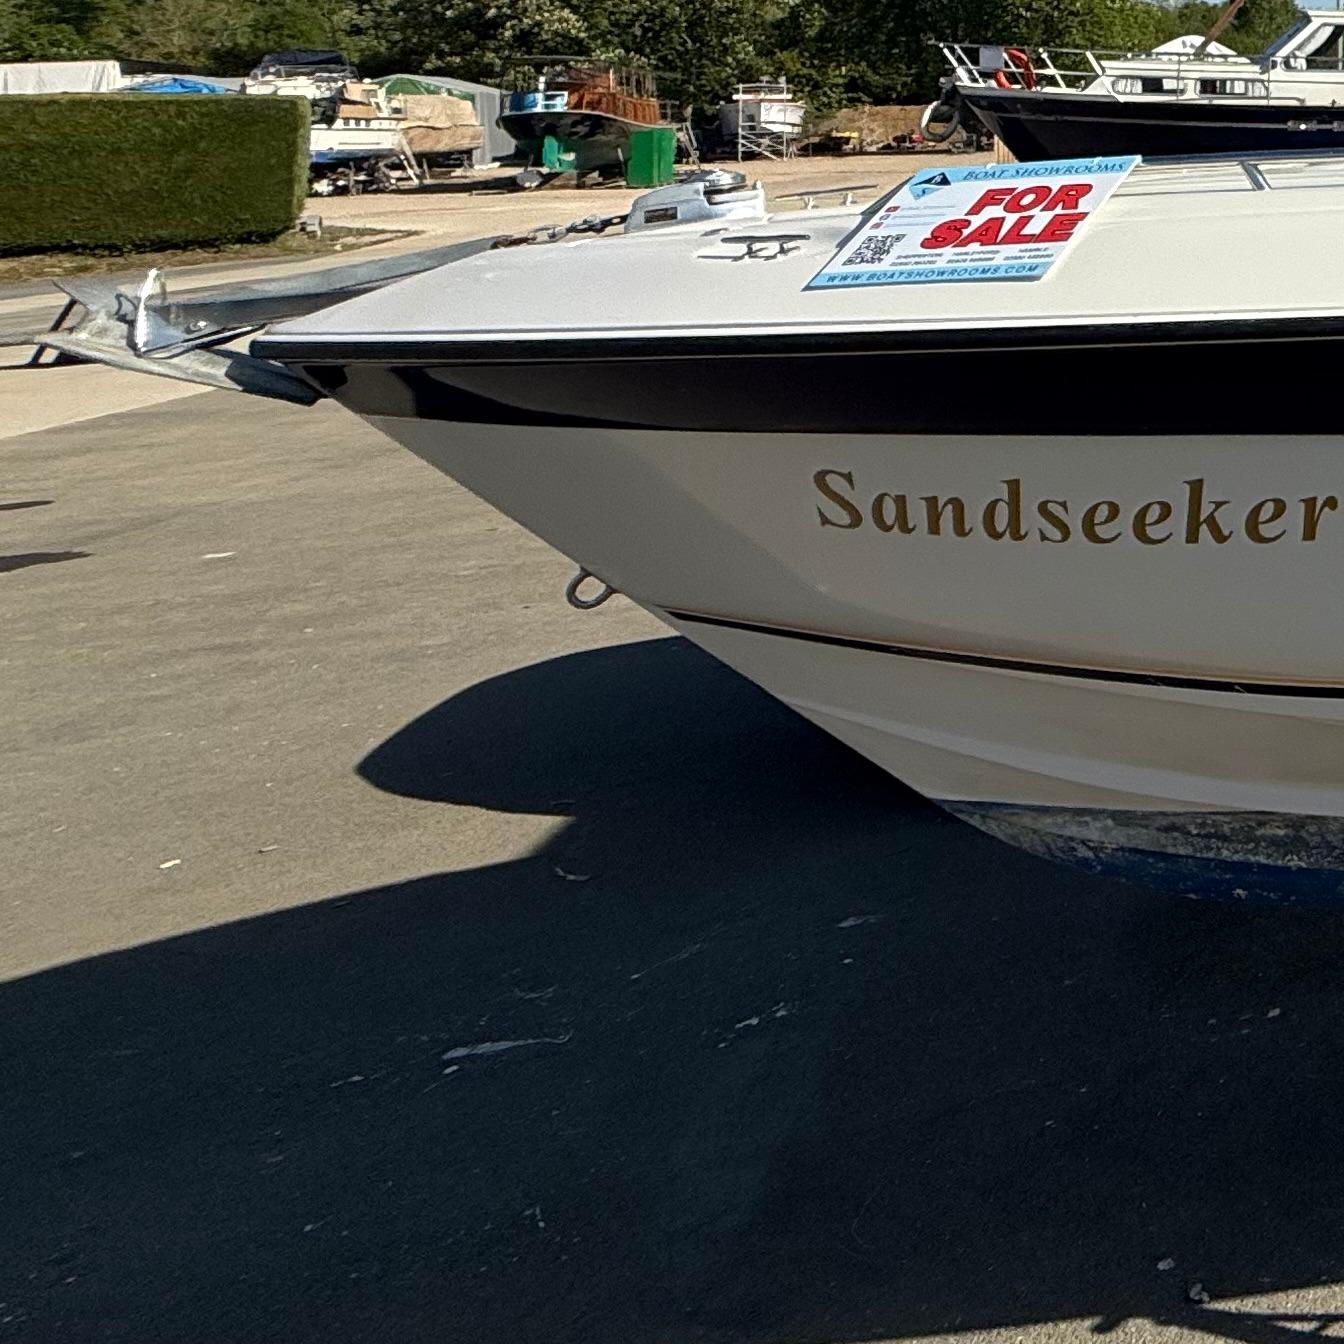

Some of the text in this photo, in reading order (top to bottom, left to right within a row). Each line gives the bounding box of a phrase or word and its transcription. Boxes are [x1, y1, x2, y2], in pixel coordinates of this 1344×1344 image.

[963, 161, 1126, 181] BOAT SHOWROOMS
[966, 183, 1094, 216] FOR
[919, 211, 1091, 250] SALE
[812, 468, 1340, 545] Sandseeker
